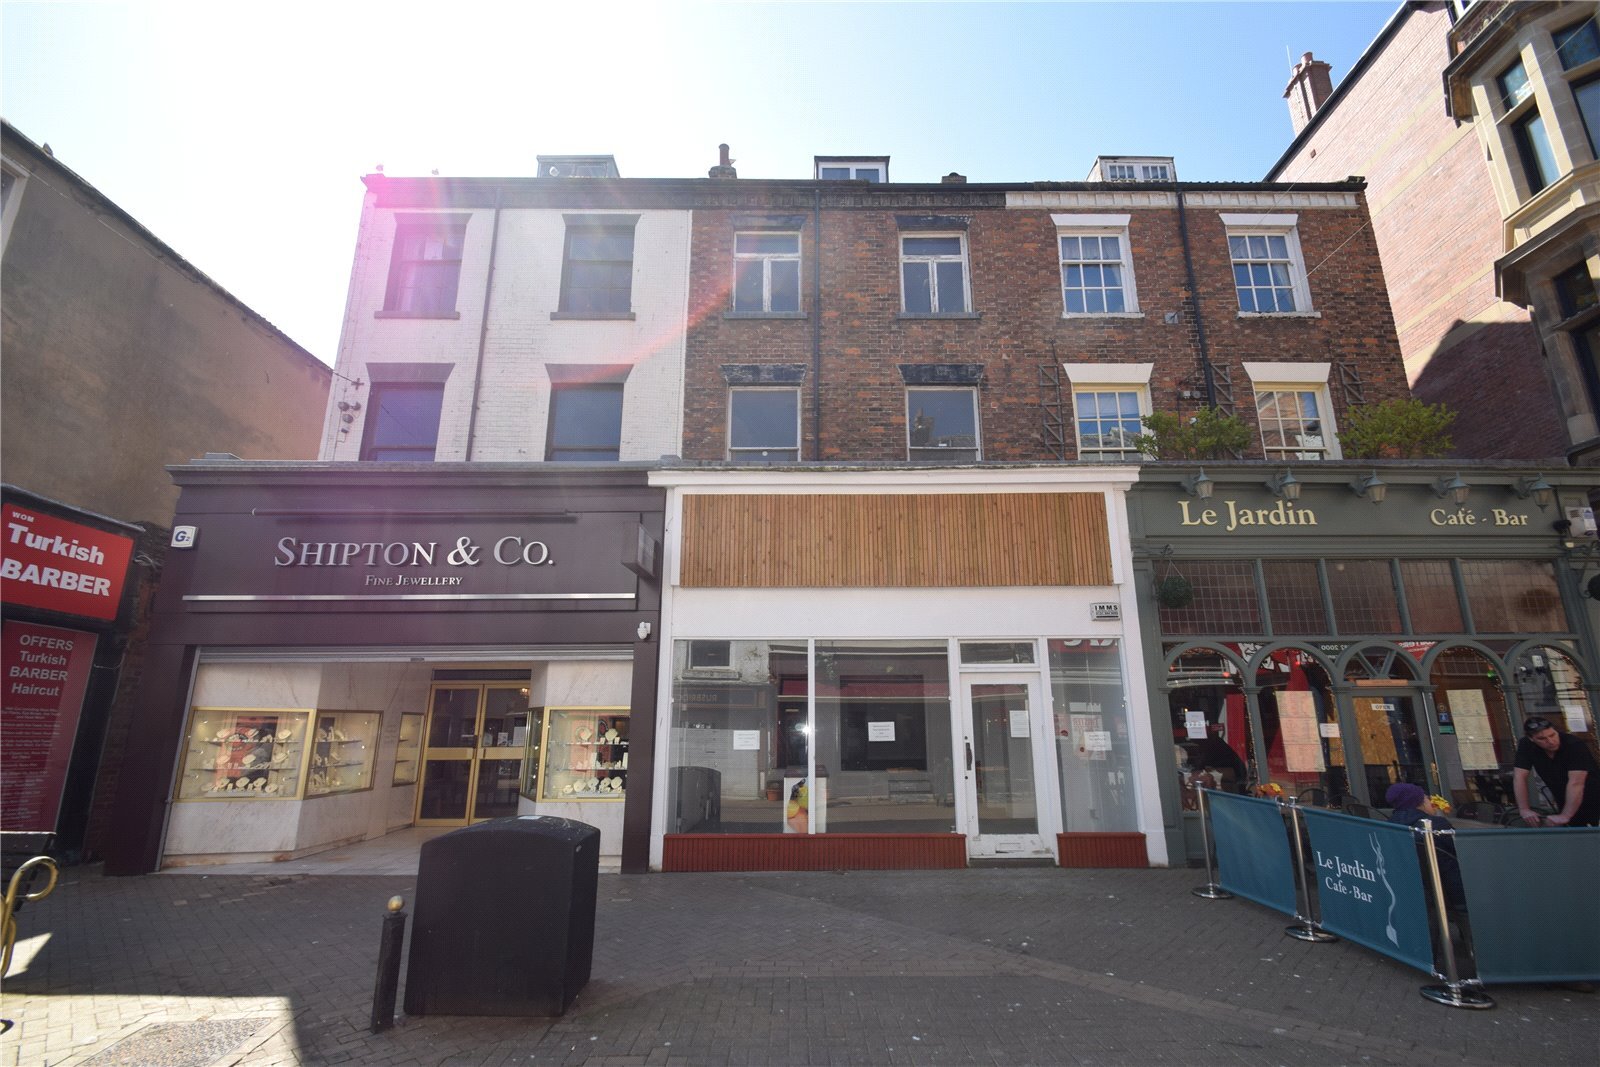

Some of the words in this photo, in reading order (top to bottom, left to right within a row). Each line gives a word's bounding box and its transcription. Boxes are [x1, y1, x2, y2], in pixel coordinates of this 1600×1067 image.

[1177, 500, 1218, 526] Le
[1223, 499, 1318, 532] Jardin
[1429, 507, 1477, 527] Café
[1491, 507, 1528, 526] Bar
[8, 522, 105, 565] Turkish
[274, 536, 438, 567] SHIPTON
[446, 536, 481, 566] &
[0, 558, 111, 597] BARBER
[20, 634, 74, 651] OFFERS
[20, 650, 67, 666] Turkish
[9, 666, 68, 682] BARBER
[11, 682, 60, 697] Haircut
[1316, 850, 1334, 870] Le
[1334, 855, 1376, 882] Jardin
[1352, 885, 1373, 903] Bar
